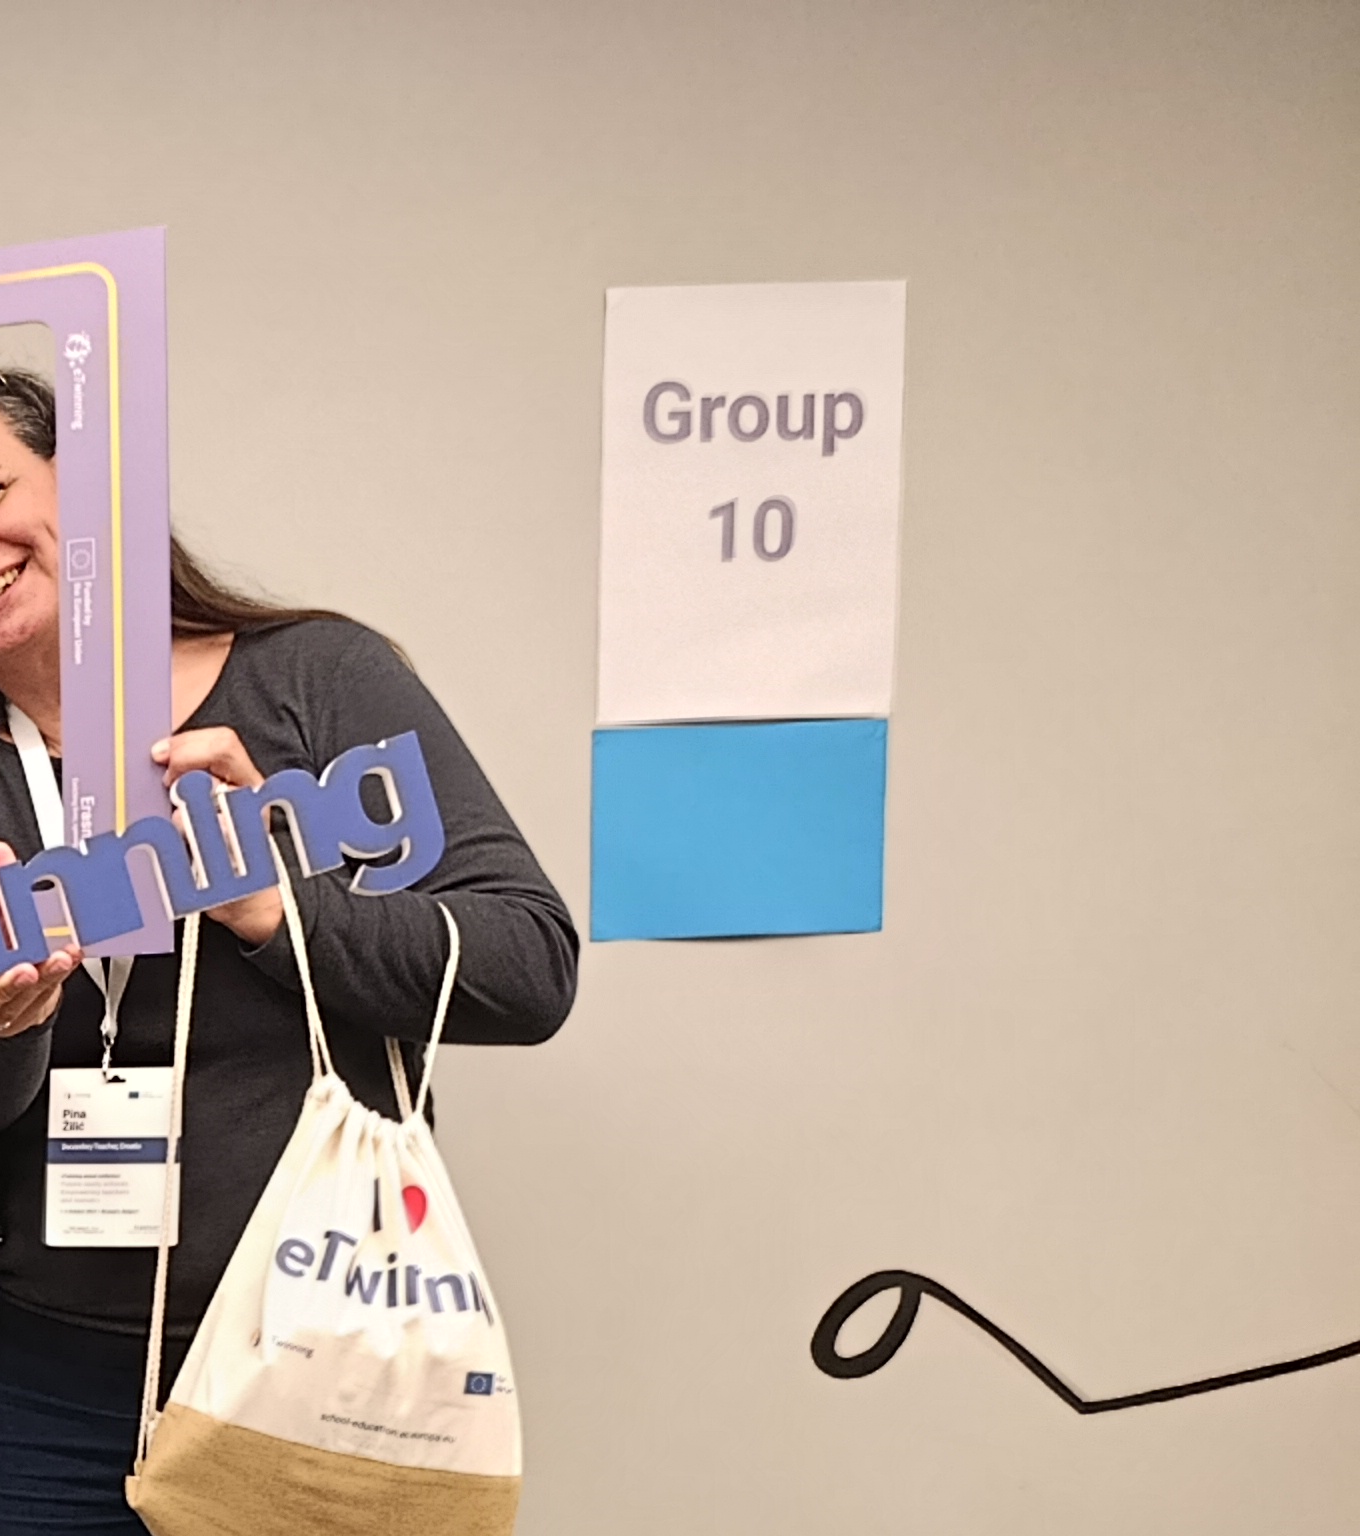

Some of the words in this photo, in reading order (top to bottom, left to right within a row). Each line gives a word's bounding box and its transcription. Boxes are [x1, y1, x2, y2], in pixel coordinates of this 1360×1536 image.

[641, 379, 866, 457] Group
[707, 495, 798, 563] 10
[63, 1109, 87, 1119] Pina
